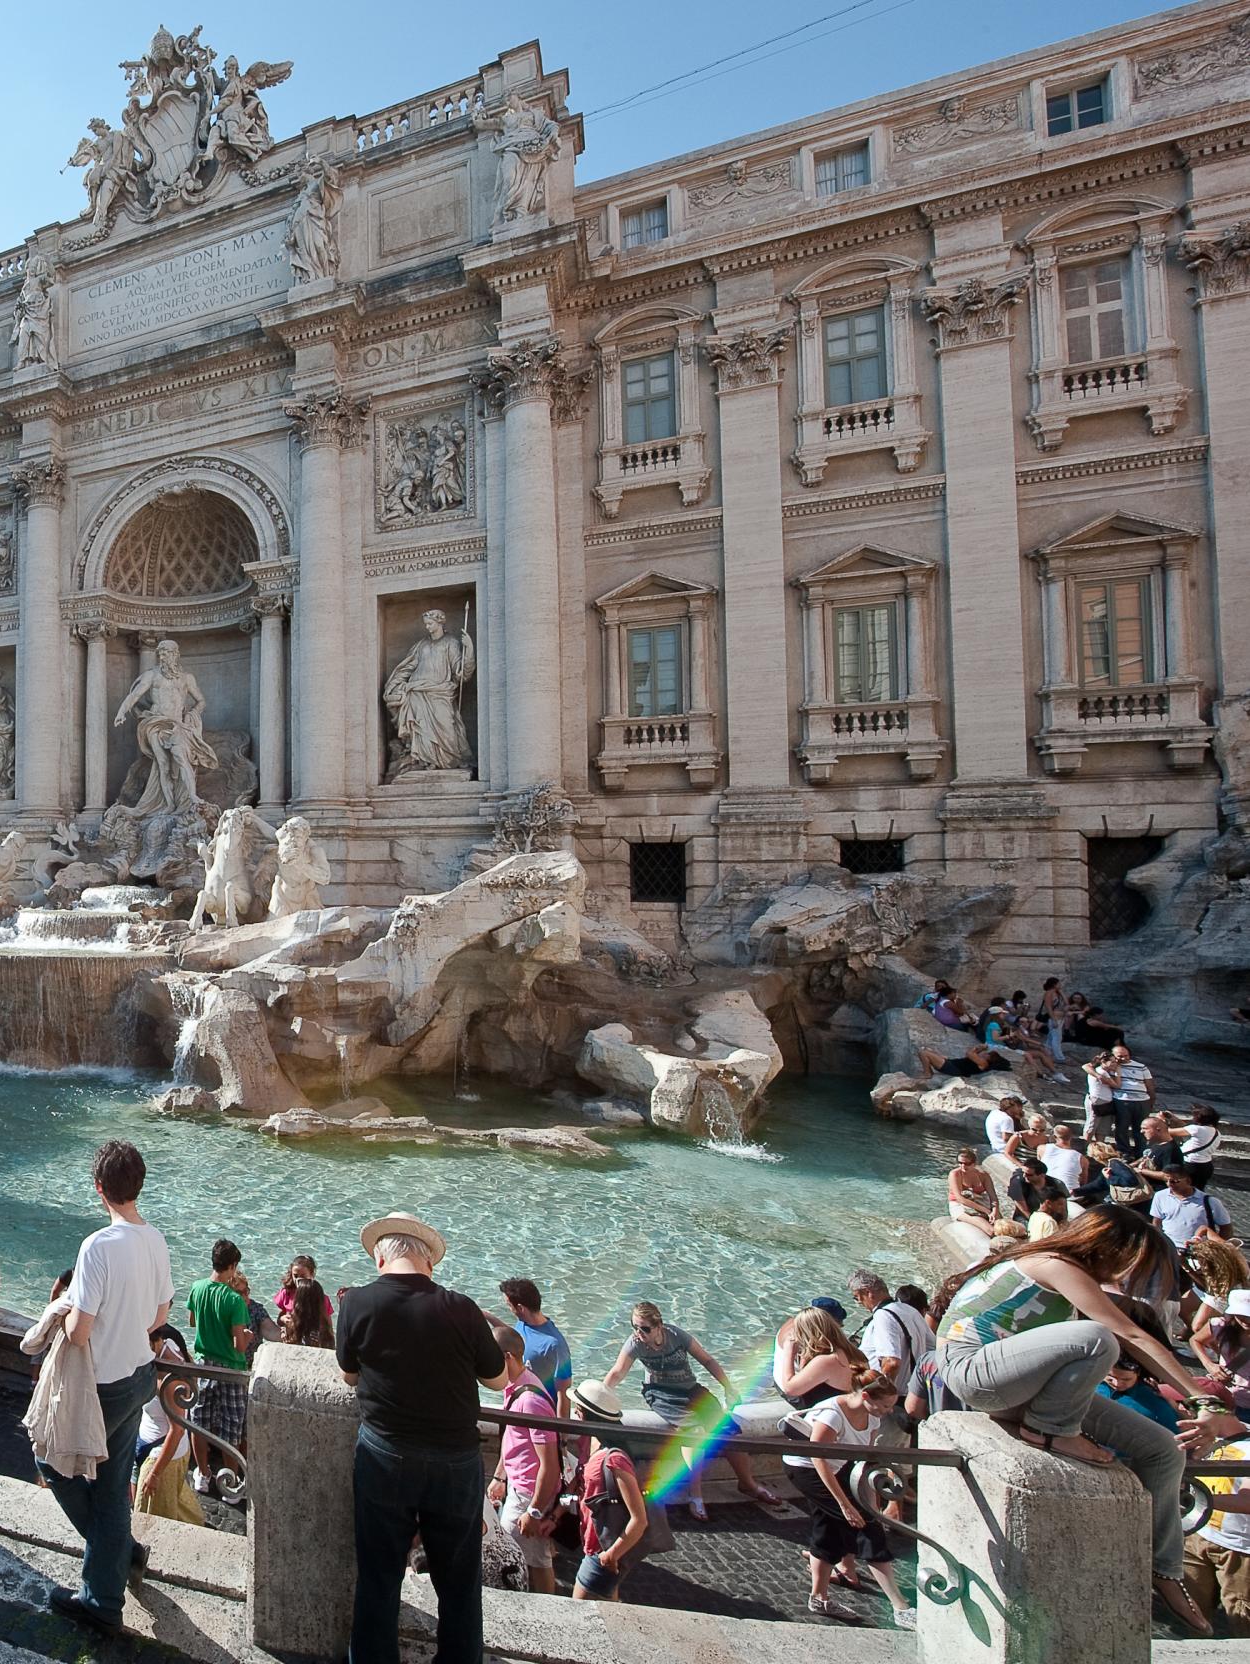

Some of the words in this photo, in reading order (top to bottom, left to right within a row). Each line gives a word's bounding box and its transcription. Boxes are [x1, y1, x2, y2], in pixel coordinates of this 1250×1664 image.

[78, 309, 106, 325] COPIA
[110, 304, 121, 315] ET
[124, 282, 190, 310] SALVBRITATE
[194, 254, 283, 287] COMMENDATAM
[88, 271, 147, 298] CLEMENS
[127, 278, 165, 298] AQVAM
[171, 259, 225, 281] VIRGINEM
[101, 311, 134, 329] CVLTV
[140, 291, 199, 317] MAGNIFICO
[204, 274, 255, 296] ORNAVIT
[82, 331, 110, 347] ANNO
[113, 319, 150, 337] DOMINI
[72, 388, 221, 441] BENEDICTVS
[240, 371, 290, 400] XIV
[364, 564, 405, 578] SOLVTVM
